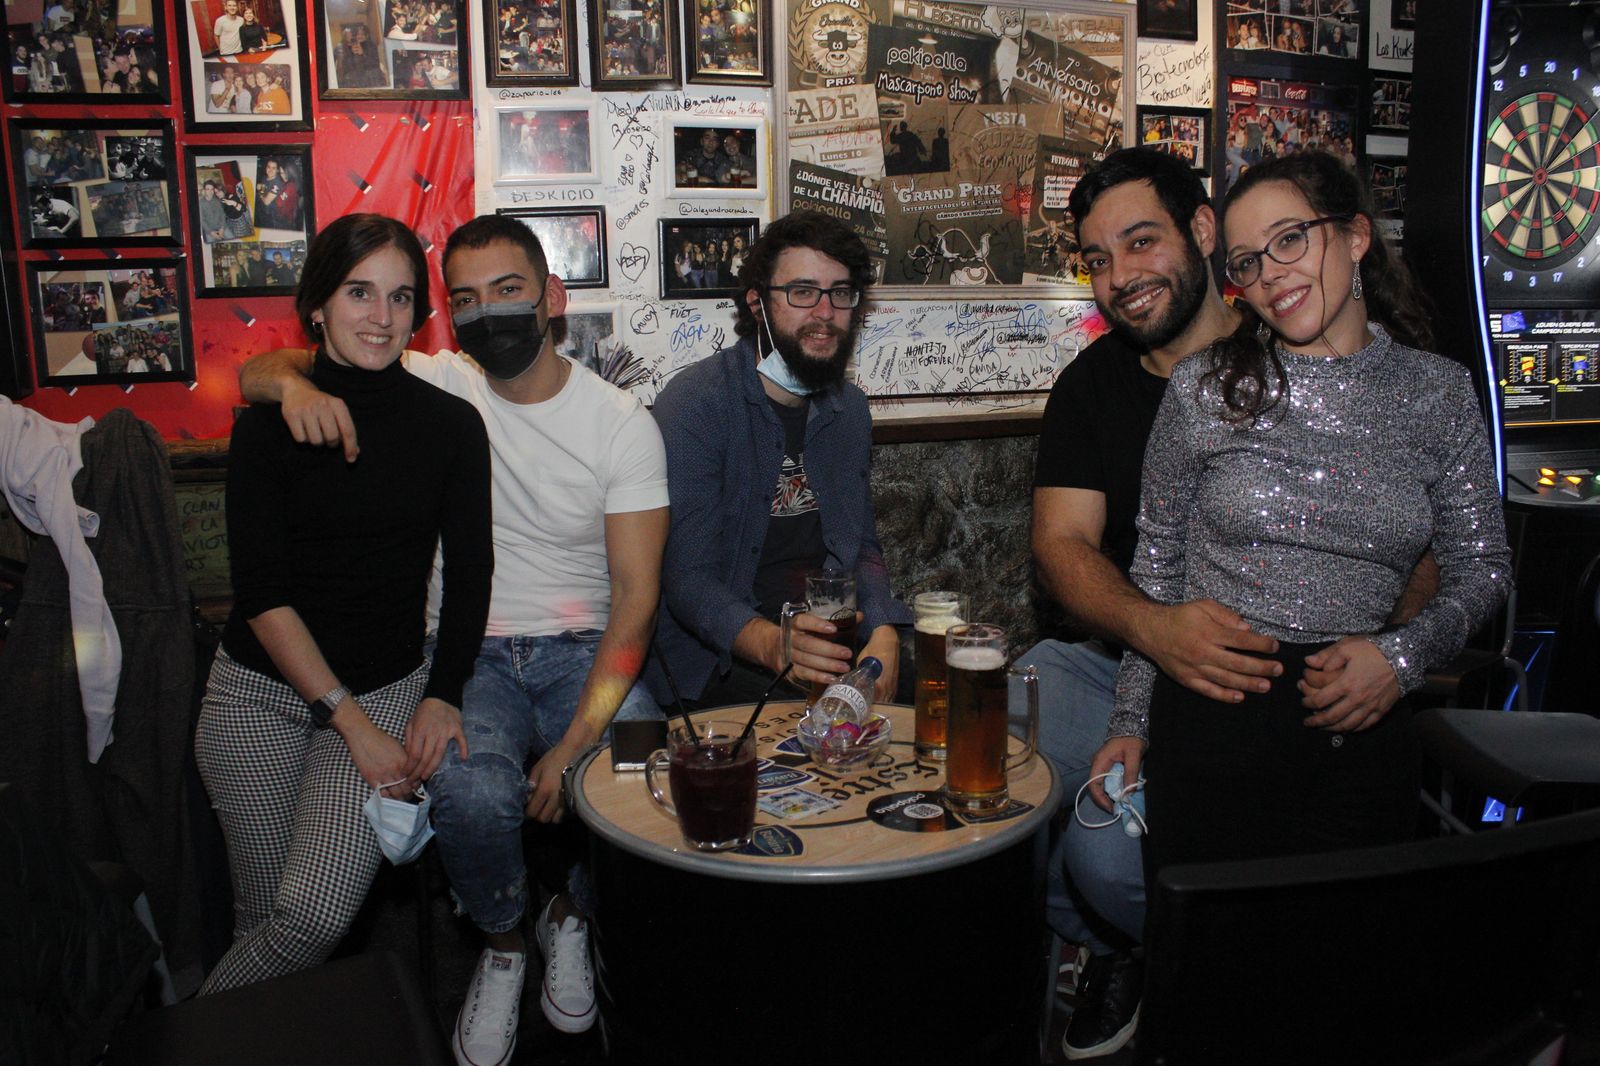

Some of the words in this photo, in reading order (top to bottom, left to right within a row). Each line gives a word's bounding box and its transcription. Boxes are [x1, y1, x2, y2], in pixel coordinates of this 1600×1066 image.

[886, 46, 967, 72] pakipalla
[825, 77, 856, 88] PRIX
[1028, 56, 1101, 97] Aniversario
[1493, 79, 1504, 91] 12
[1519, 64, 1528, 78] 5
[1544, 61, 1556, 73] 20
[1571, 67, 1580, 81] 1
[794, 93, 859, 124] ADE
[983, 111, 1027, 128] FIESTA
[821, 152, 848, 161] Lunes
[850, 150, 862, 158] 10
[793, 185, 806, 196] DE
[807, 188, 820, 199] LA
[796, 170, 832, 187] ¿DÓNDE
[833, 180, 851, 192] VES
[851, 185, 864, 195] LA
[897, 186, 954, 203] GRAND
[959, 182, 1002, 198] PRIX
[1483, 255, 1490, 267] 7
[1503, 271, 1513, 282] 19
[1529, 275, 1536, 287] 3
[1552, 272, 1563, 282] 17
[1577, 257, 1585, 268] 2
[669, 307, 698, 319] FUET
